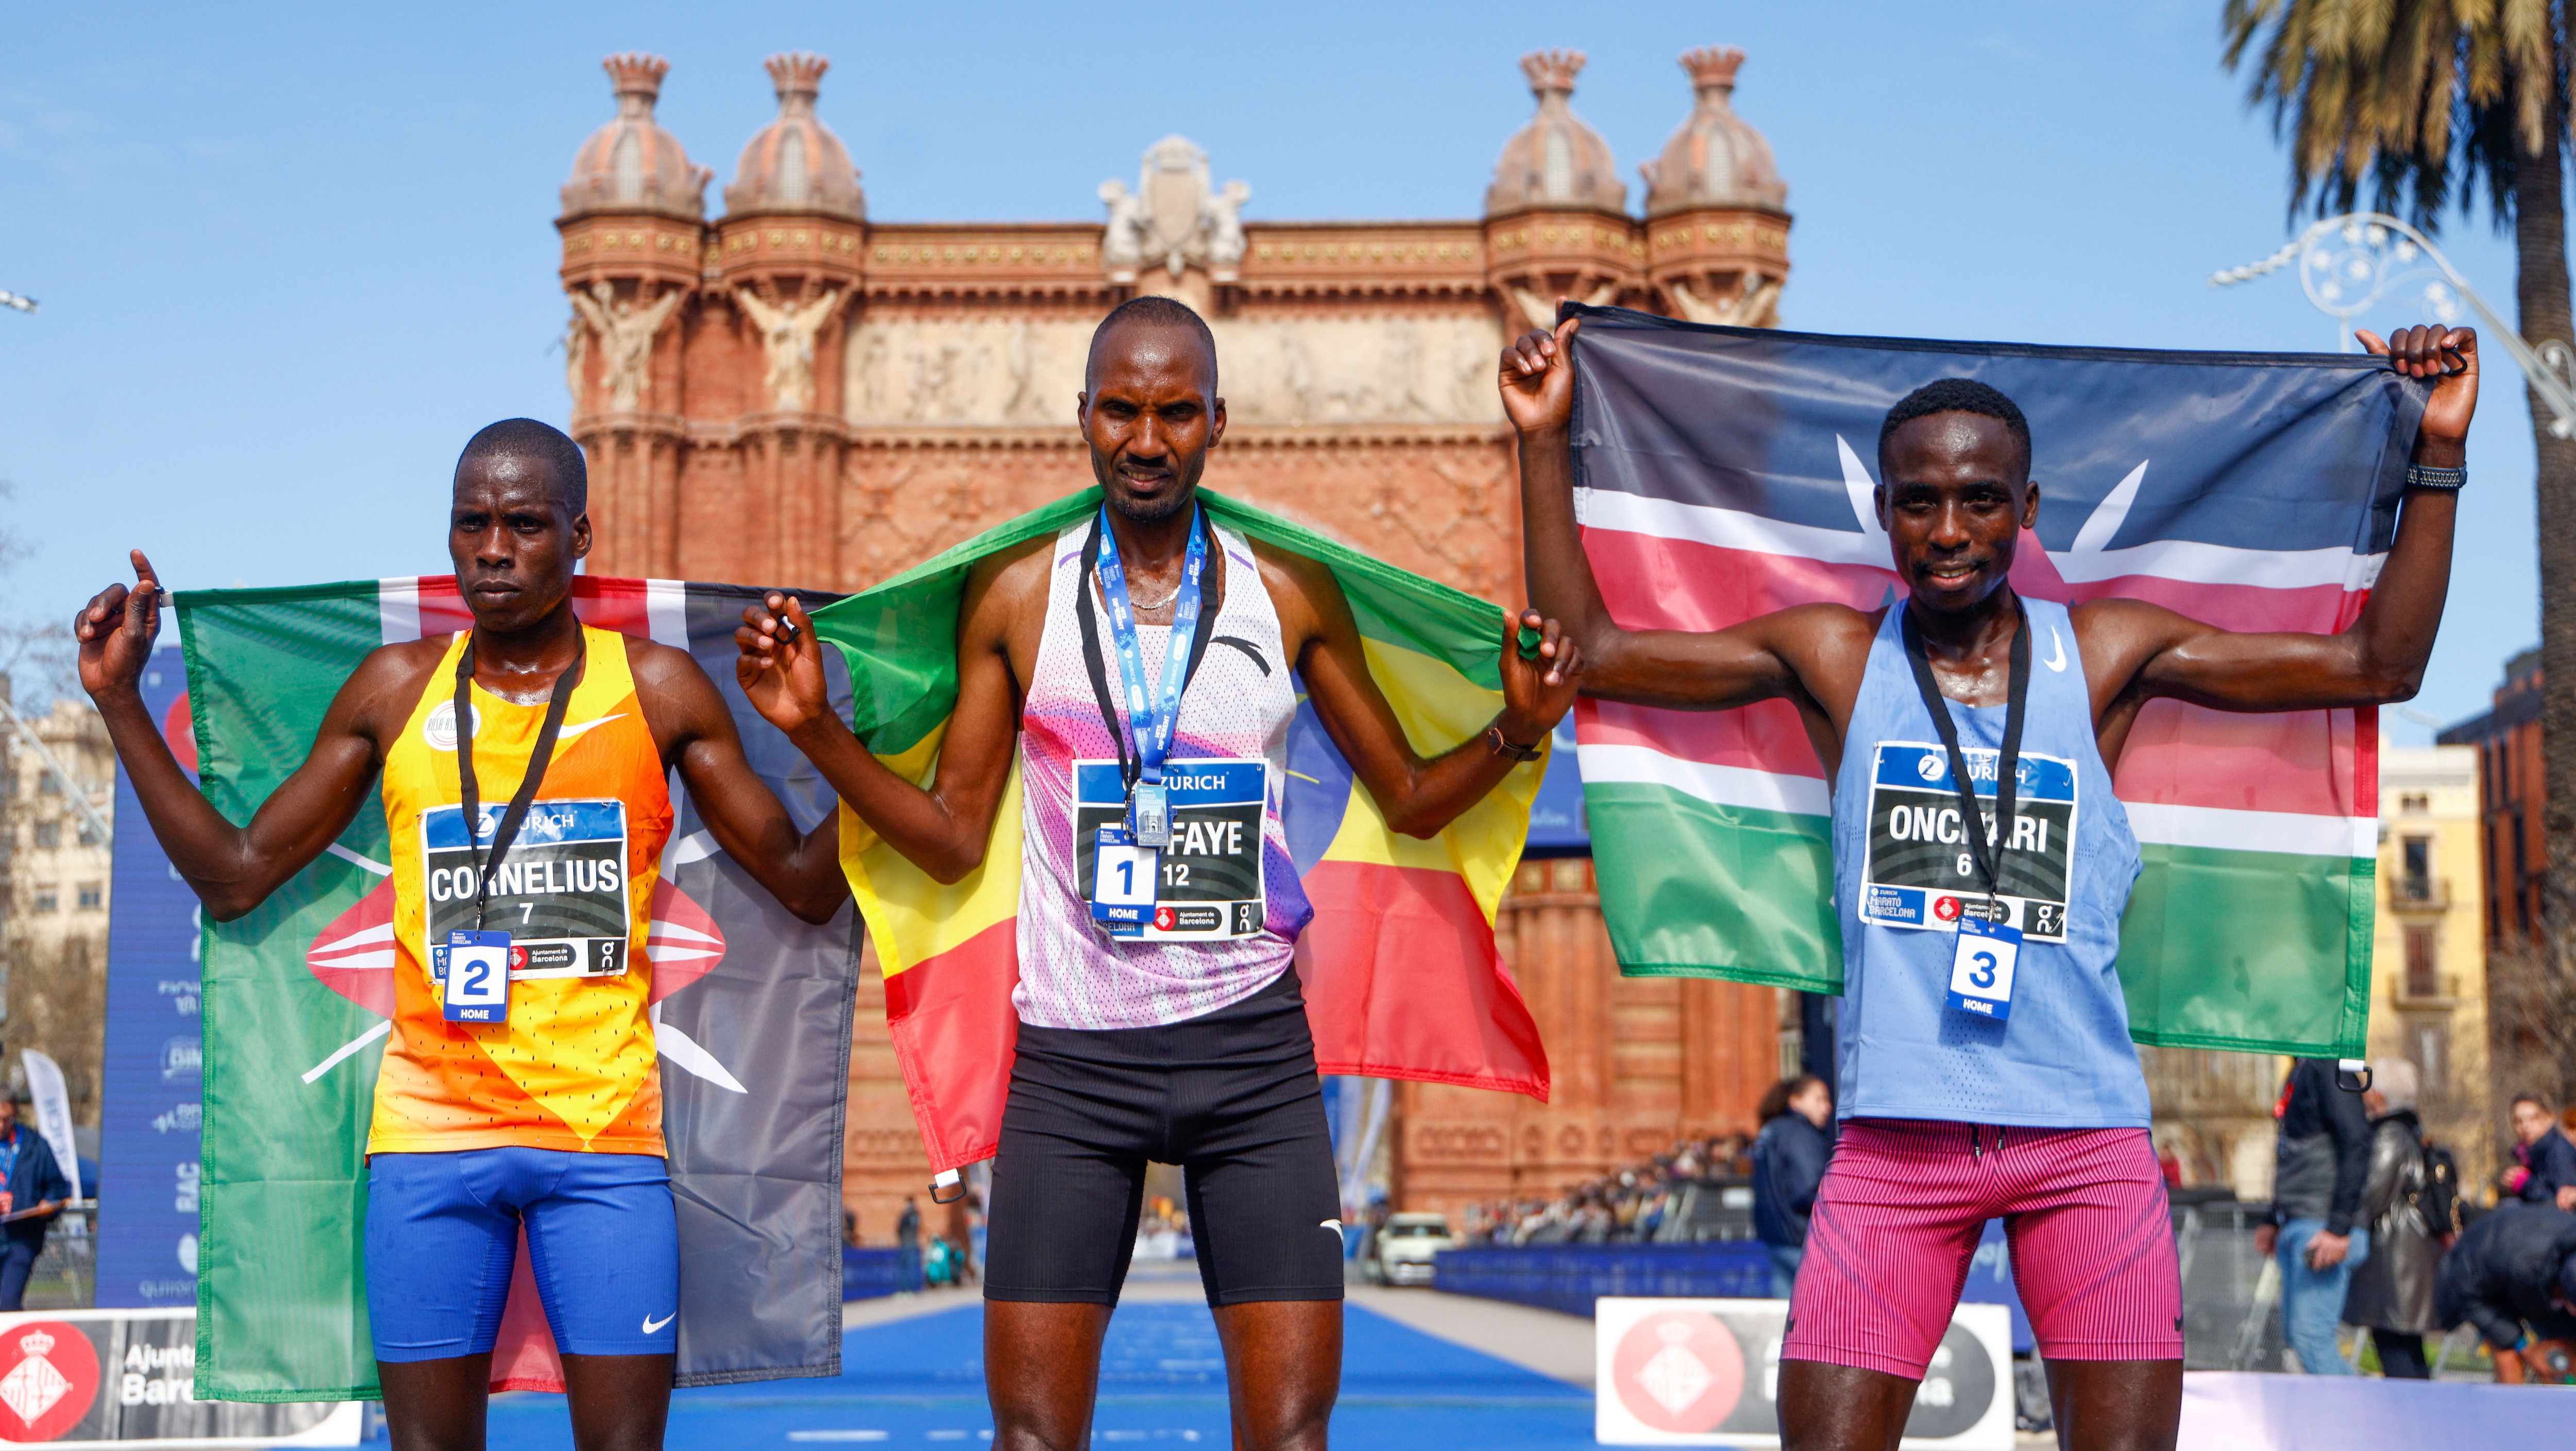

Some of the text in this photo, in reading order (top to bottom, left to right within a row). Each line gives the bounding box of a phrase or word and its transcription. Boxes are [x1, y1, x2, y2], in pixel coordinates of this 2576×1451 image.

[1127, 660, 1136, 682] ZURICH
[1170, 663, 1179, 685] ZURICH
[427, 718, 444, 731] ROSA
[1161, 775, 1225, 791] ZURICH
[520, 814, 574, 830] URICH
[1957, 853, 1972, 876] 6
[1117, 860, 1133, 895] 1
[1163, 864, 1189, 886] 12
[519, 902, 534, 925] 7
[1109, 908, 1138, 919] HOME
[1869, 906, 1916, 918] BARCELONA
[1179, 917, 1215, 925] Barcelona
[532, 954, 568, 963] Barcelona
[463, 959, 490, 996] 2
[1969, 950, 1997, 989] 3
[461, 1009, 489, 1020] HOME
[1963, 998, 1993, 1015] HOME
